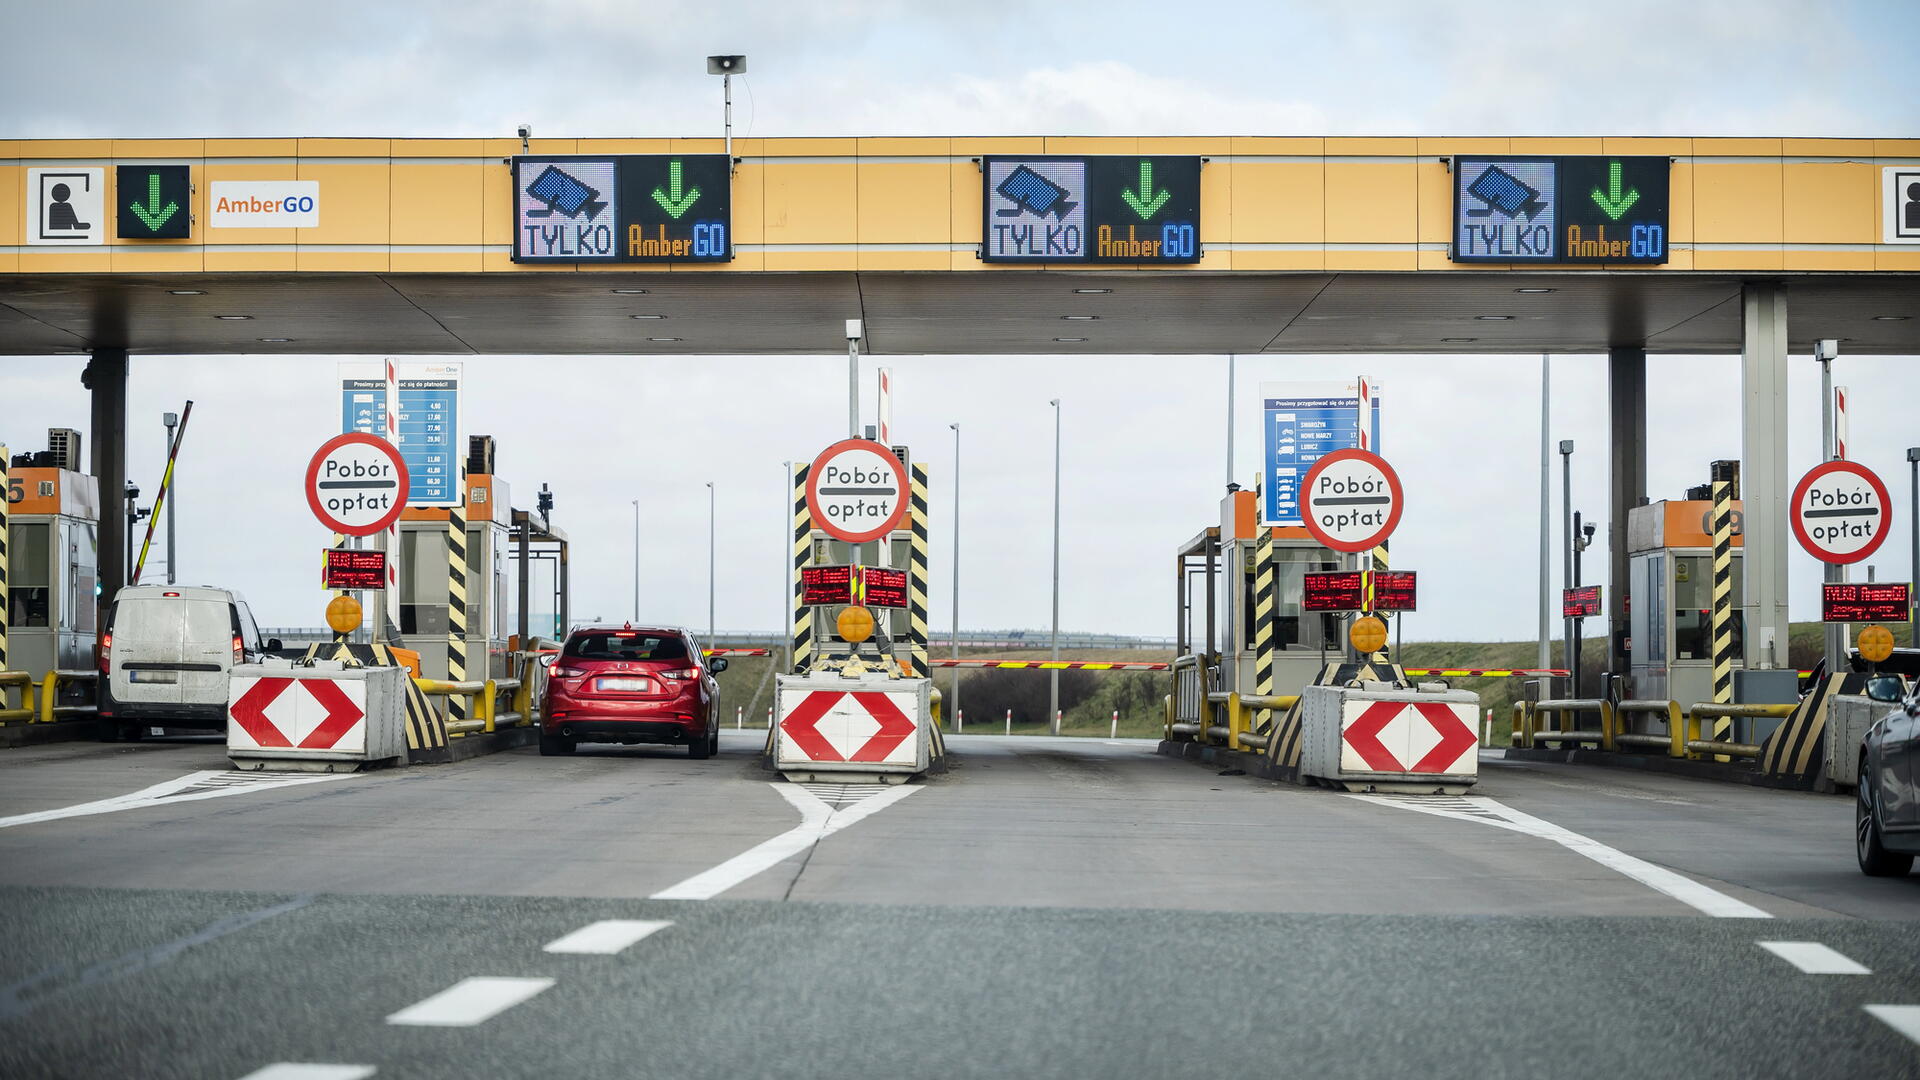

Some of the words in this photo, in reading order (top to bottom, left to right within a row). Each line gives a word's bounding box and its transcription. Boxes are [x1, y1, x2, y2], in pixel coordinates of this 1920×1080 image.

[216, 196, 314, 213] AmberGO
[523, 225, 612, 255] TYLKO
[628, 224, 725, 257] AmberGO
[993, 224, 1081, 255] TYLKO
[1098, 224, 1194, 257] AmberGO
[1463, 225, 1551, 255] TYLKO
[1567, 224, 1663, 257] AmberGO
[353, 381, 374, 389] Prosimy
[326, 459, 389, 478] Pobór
[827, 466, 890, 484] Pobór
[1320, 475, 1383, 494] Pobór
[327, 492, 388, 516] opłat
[1810, 487, 1872, 507] Pobór
[827, 499, 888, 522] opłat
[1322, 508, 1383, 532] opłat
[1813, 520, 1872, 544] opłat
[1824, 586, 1856, 601] TYLKO
